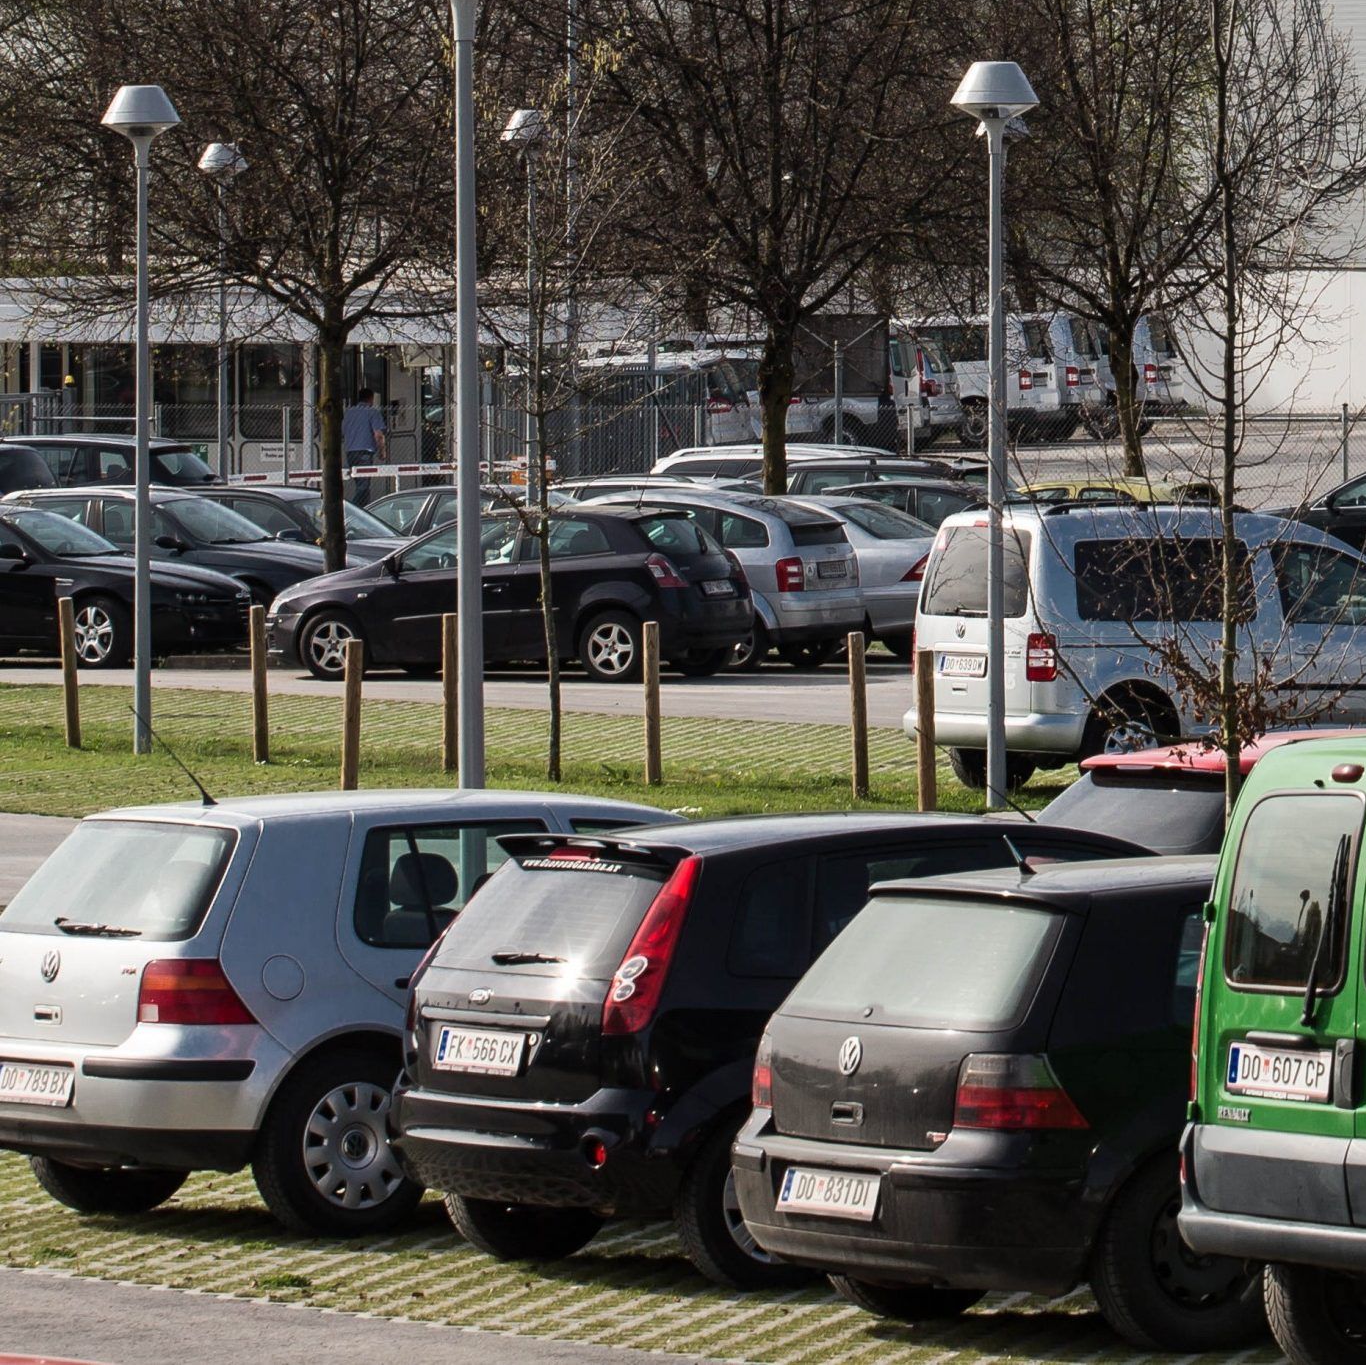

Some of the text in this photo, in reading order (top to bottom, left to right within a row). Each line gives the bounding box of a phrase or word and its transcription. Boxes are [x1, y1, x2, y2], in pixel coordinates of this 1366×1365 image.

[448, 1035, 466, 1059] FK
[1, 1067, 18, 1090] DO
[1241, 1053, 1261, 1081] DO
[795, 1174, 817, 1200] DO
